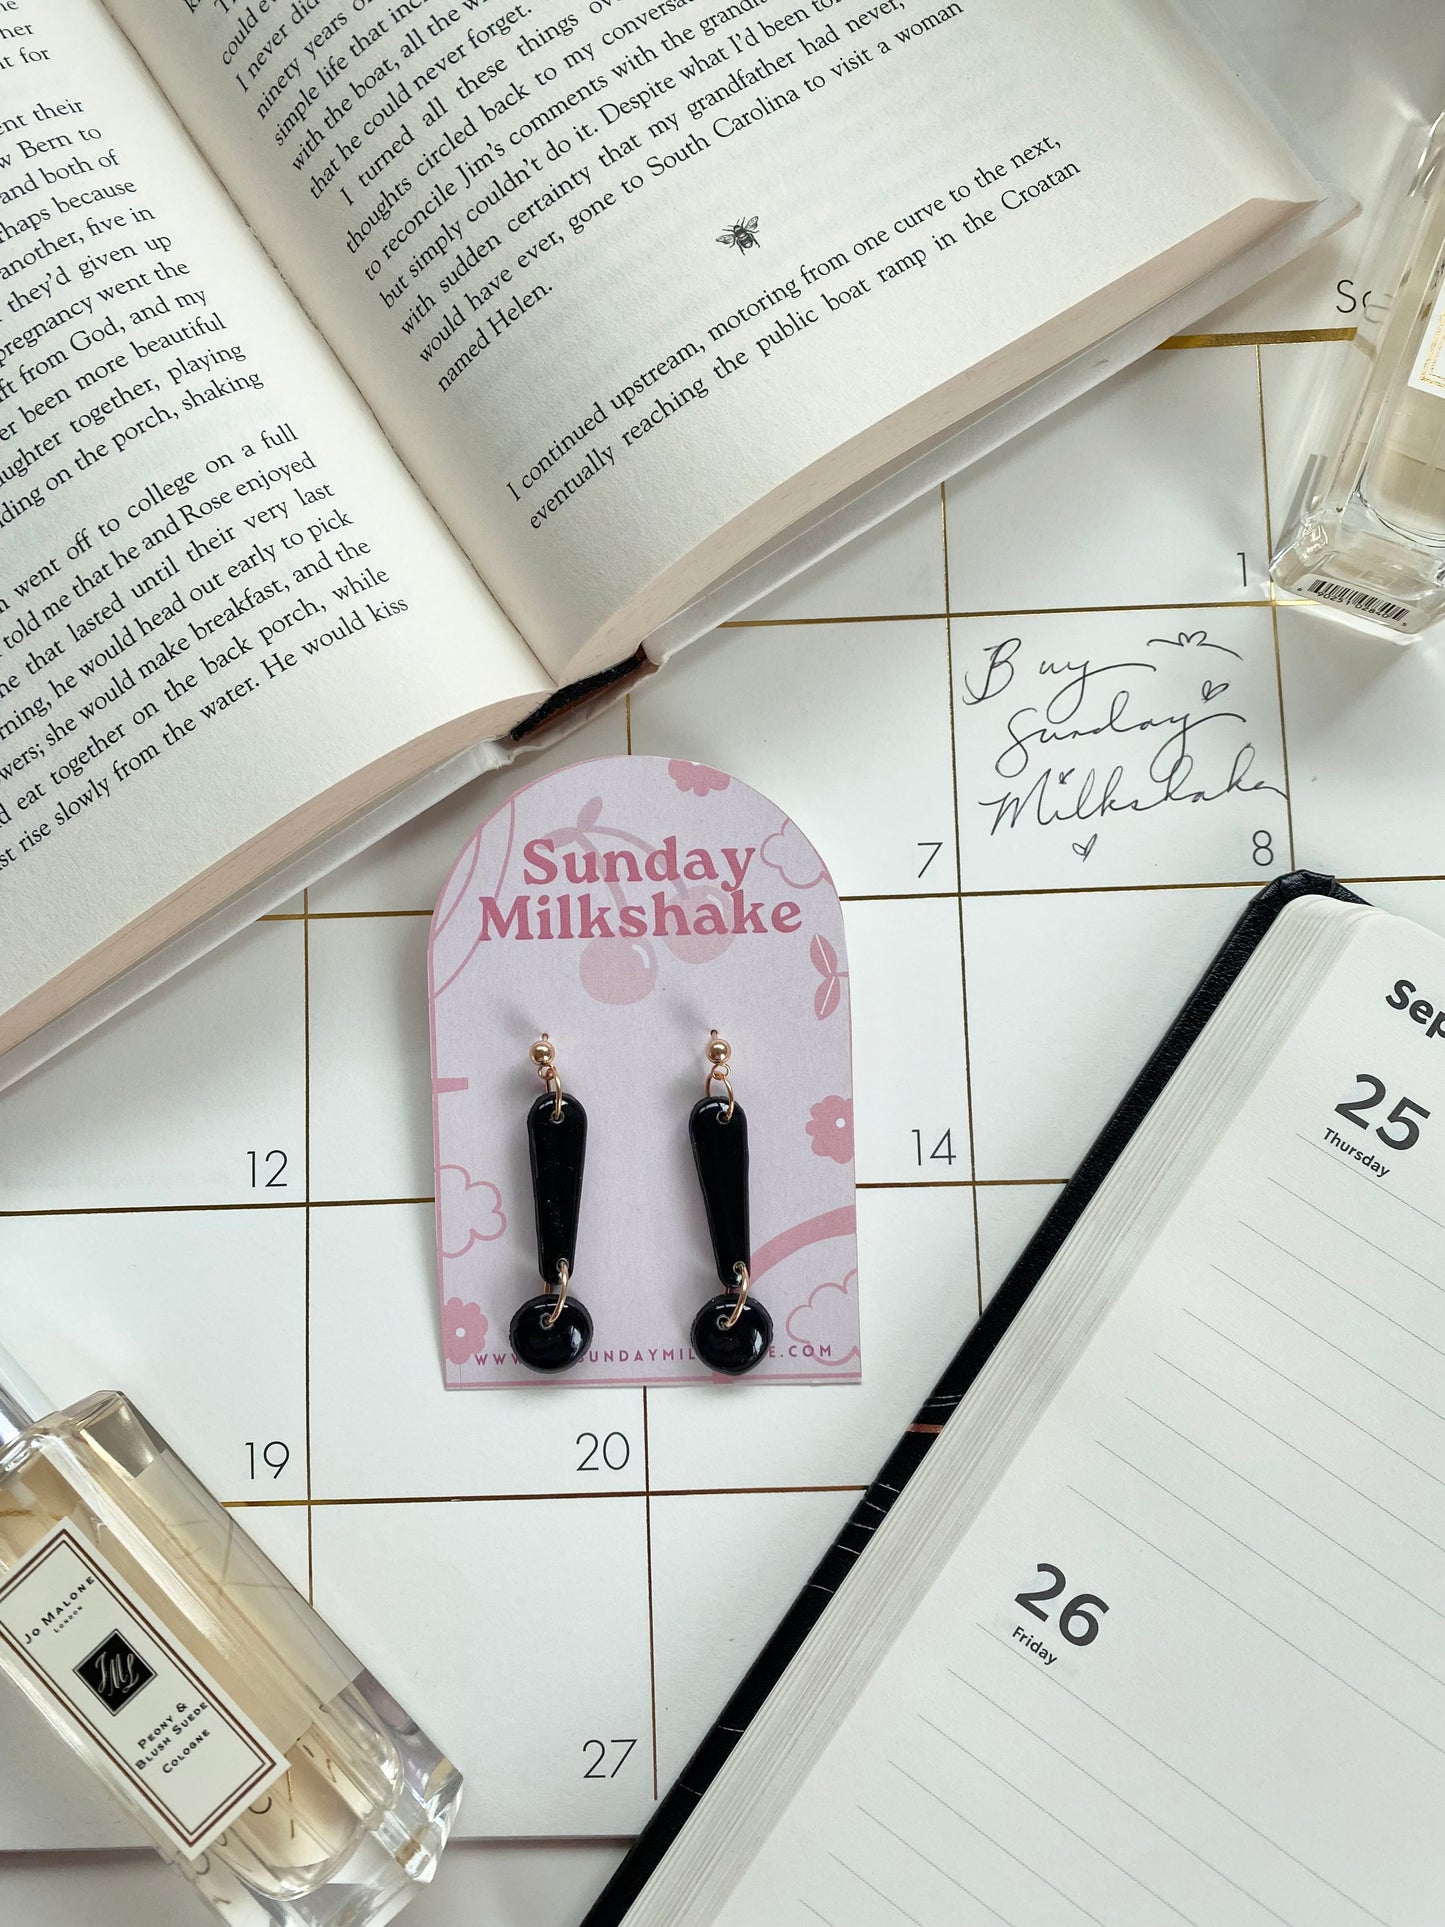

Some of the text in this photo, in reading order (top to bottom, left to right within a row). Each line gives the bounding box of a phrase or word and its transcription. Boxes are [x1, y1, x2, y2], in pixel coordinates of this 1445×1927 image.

[19, 47, 50, 63] for
[235, 74, 248, 93] I
[248, 24, 288, 79] never
[257, 57, 301, 120] ninety
[304, 12, 347, 60] years
[275, 87, 320, 146] simple
[316, 55, 349, 88] life
[349, 20, 389, 57] that
[33, 99, 84, 121] their
[310, 158, 341, 199] that
[335, 136, 362, 162] he
[364, 81, 413, 135] could
[412, 44, 467, 91] never
[467, 5, 532, 49] forget.
[0, 172, 40, 204] and
[38, 156, 94, 184] both
[98, 149, 119, 167] of
[16, 129, 101, 159] Bern to
[346, 177, 412, 254] thoughts
[417, 115, 479, 176] circled
[477, 82, 531, 122] back
[534, 67, 557, 86] to
[563, 43, 594, 69] my
[379, 9, 811, 309] but simply couldn't do it. Despite what I'd been
[401, 0, 905, 335] with sudden certainty that my grandfather had never,
[51, 182, 137, 213] because
[0, 208, 156, 280] another, five in
[7, 237, 171, 313] they'd given up
[96, 274, 152, 301] went
[153, 262, 190, 280] the
[19, 291, 206, 385] from God, and my
[438, 286, 552, 393] named Helen.
[506, 137, 1061, 502] I continued upstream, motoring from one curve to the next,
[530, 163, 1081, 529] eventually reaching the public boat ramp in the Croatan
[17, 389, 72, 424] been
[75, 355, 128, 391] more
[129, 312, 227, 358] beautiful
[69, 379, 160, 433] together,
[167, 346, 246, 385] playing
[46, 373, 264, 491] on the porch, shaking
[3, 610, 42, 649] told
[41, 595, 72, 621] me
[72, 563, 114, 597] that
[109, 546, 140, 569] he
[142, 513, 182, 550] and
[177, 492, 233, 526] Rose
[236, 451, 317, 496] enjoyed
[1236, 552, 1247, 587] 1
[48, 675, 78, 699] he
[78, 625, 138, 677] would
[133, 591, 188, 637] head
[190, 574, 225, 601] out
[228, 544, 276, 578] early
[280, 533, 304, 549] to
[307, 509, 354, 543] pick
[17, 568, 389, 810] eat together on the back porch, while
[963, 637, 1156, 724] Buy
[18, 599, 408, 853] rise slowly from the water. He would kiss
[995, 690, 1246, 782] Sunday
[978, 742, 1289, 836] Milkshake
[523, 835, 756, 892] Sunday
[917, 842, 943, 878] 7
[1252, 830, 1274, 866] 8
[478, 889, 803, 942] Milkshake
[911, 1127, 957, 1167] 14
[1334, 1073, 1431, 1151] 25
[246, 1149, 288, 1188] 12
[1322, 1127, 1391, 1178] Thursday
[244, 1440, 290, 1480] 19
[576, 1431, 630, 1471] 20
[1014, 1563, 1110, 1647] 26
[1012, 1625, 1058, 1666] Friday
[175, 1702, 188, 1713] &
[582, 1738, 638, 1779] 27
